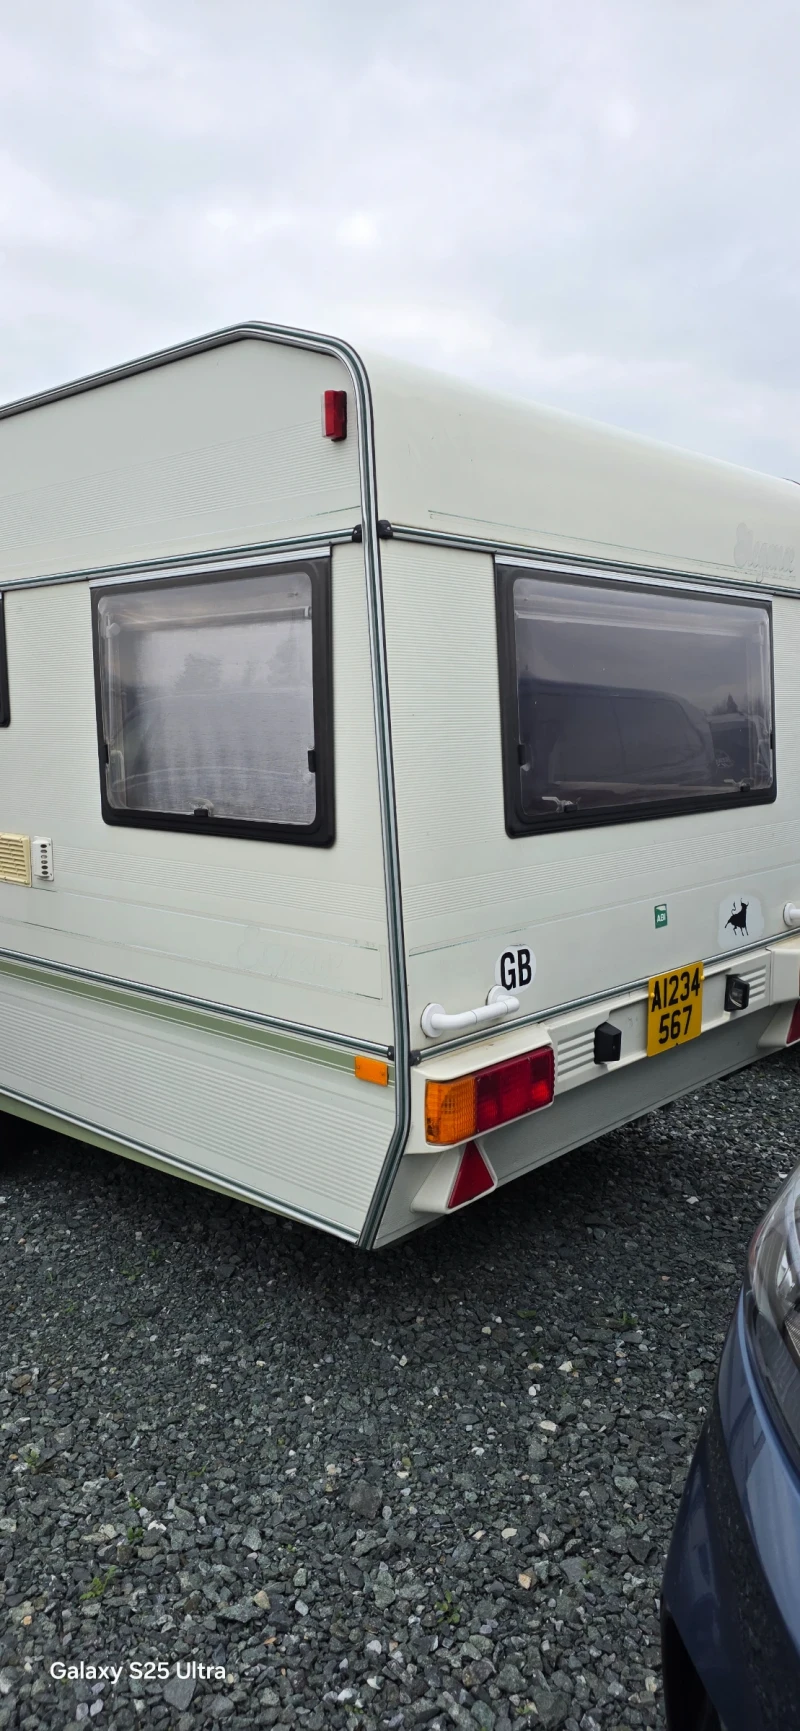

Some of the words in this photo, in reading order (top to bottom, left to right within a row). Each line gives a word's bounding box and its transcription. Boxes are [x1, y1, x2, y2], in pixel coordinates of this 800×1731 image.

[500, 948, 532, 991] GB
[651, 967, 700, 1012] A1234
[658, 1004, 693, 1045] 567
